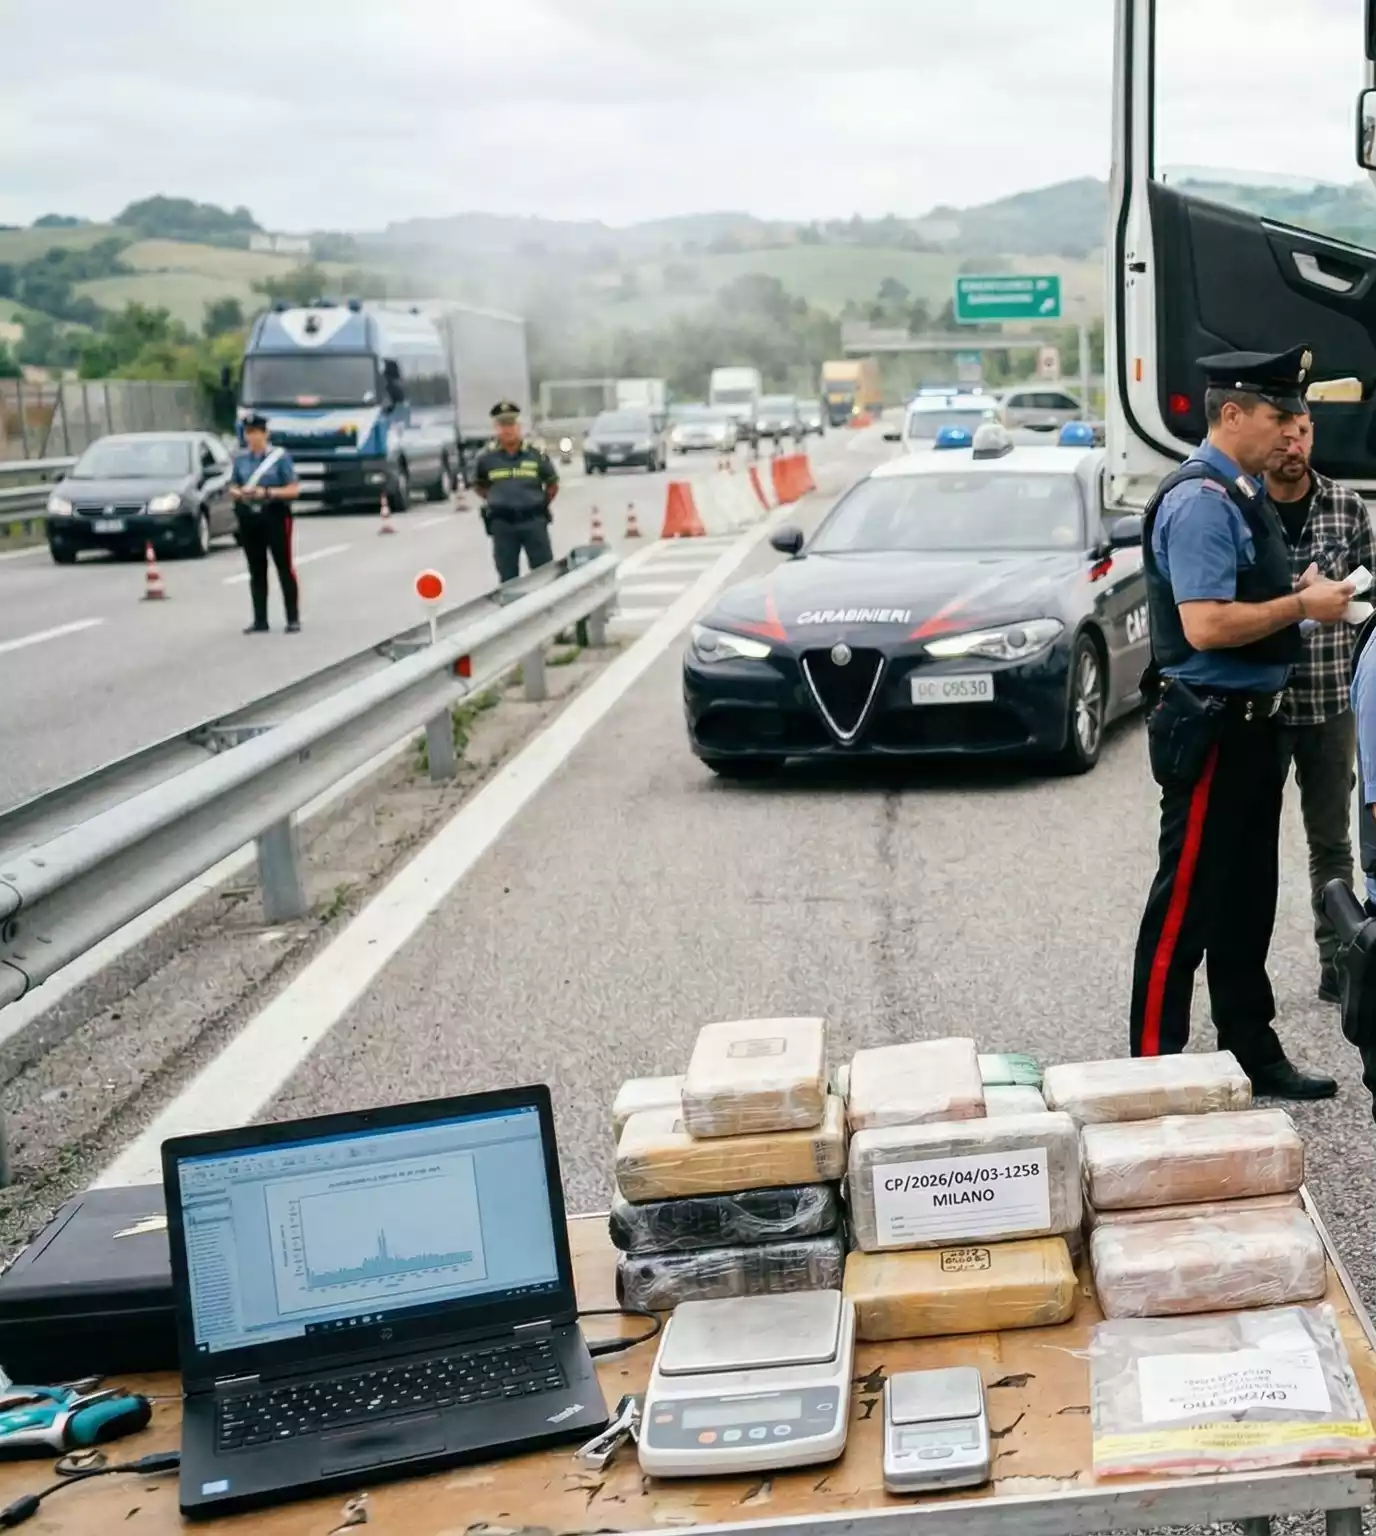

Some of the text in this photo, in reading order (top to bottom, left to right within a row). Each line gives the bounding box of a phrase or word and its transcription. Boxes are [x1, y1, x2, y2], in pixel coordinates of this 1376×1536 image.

[796, 608, 912, 624] CARABINIERI
[884, 1163, 1040, 1193] CP/2026/04/03-1258
[932, 1188, 995, 1208] MILANO
